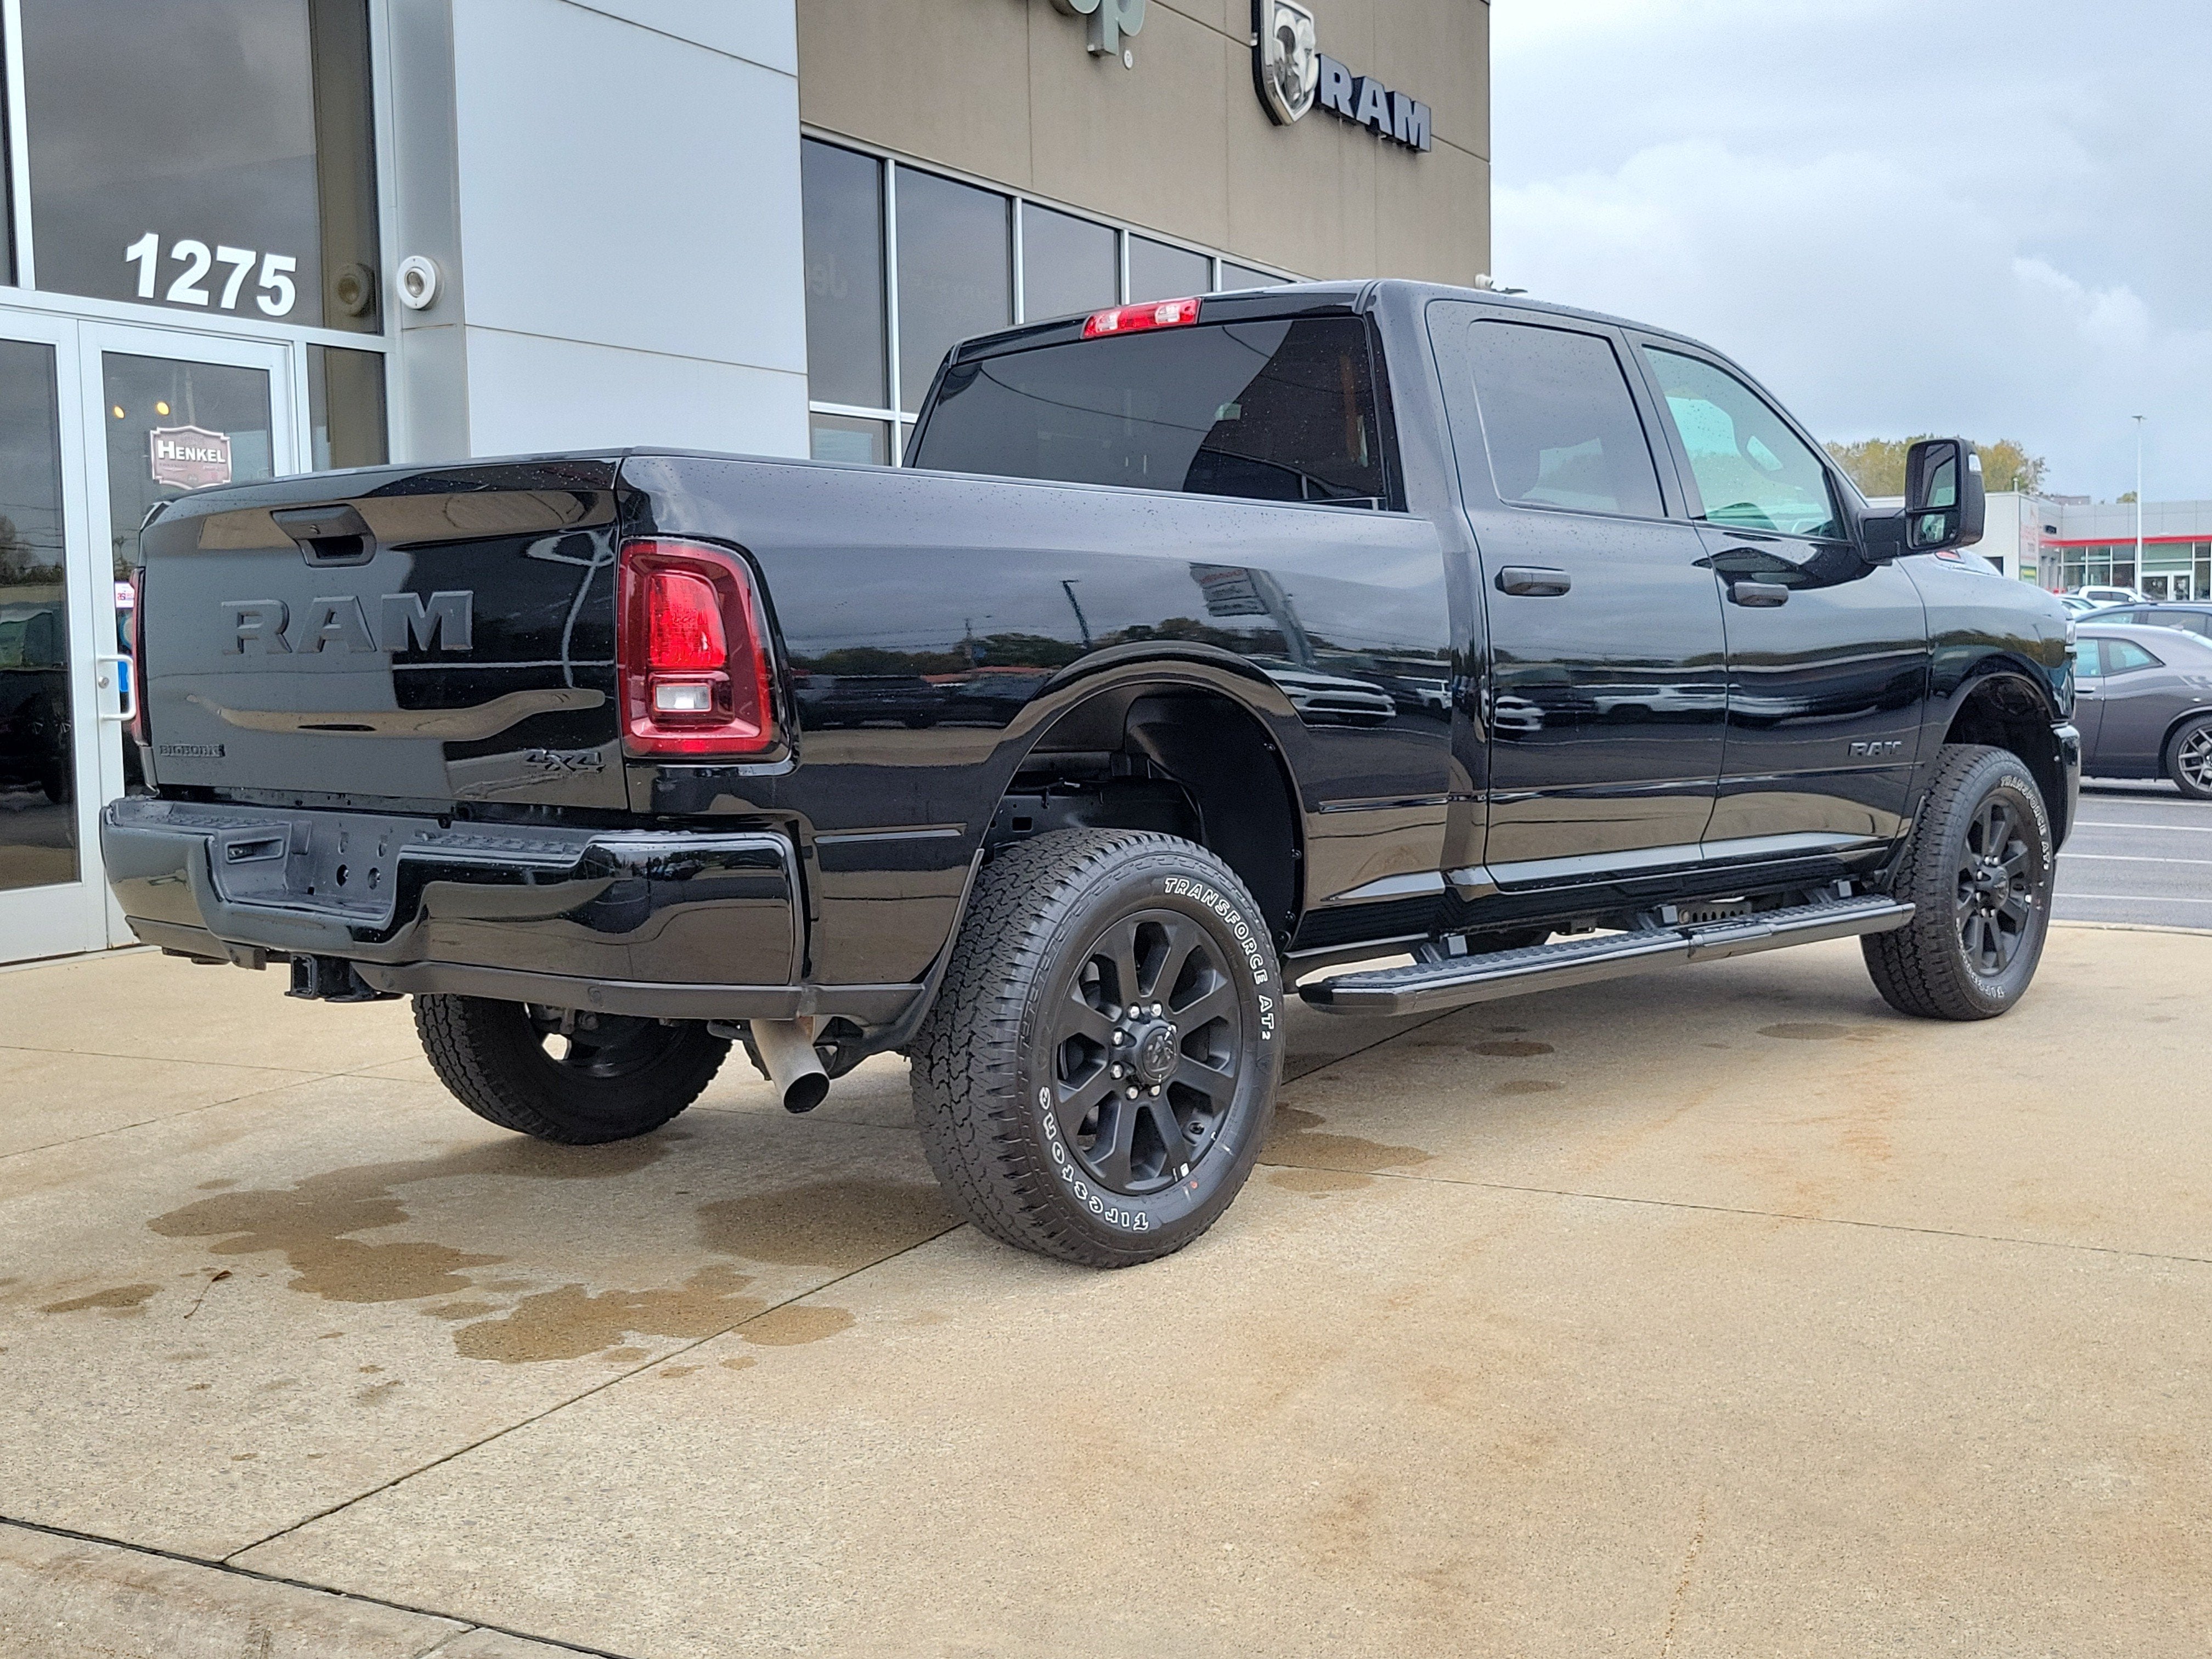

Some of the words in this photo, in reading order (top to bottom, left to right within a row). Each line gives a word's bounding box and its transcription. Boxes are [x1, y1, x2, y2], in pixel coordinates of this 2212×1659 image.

[1318, 53, 1431, 153] RAM
[126, 233, 296, 317] 1275
[157, 440, 225, 463] HENKEL
[221, 590, 473, 654] RAM
[1848, 741, 1902, 756] RAM
[1165, 878, 1268, 985] TRANSFORCE
